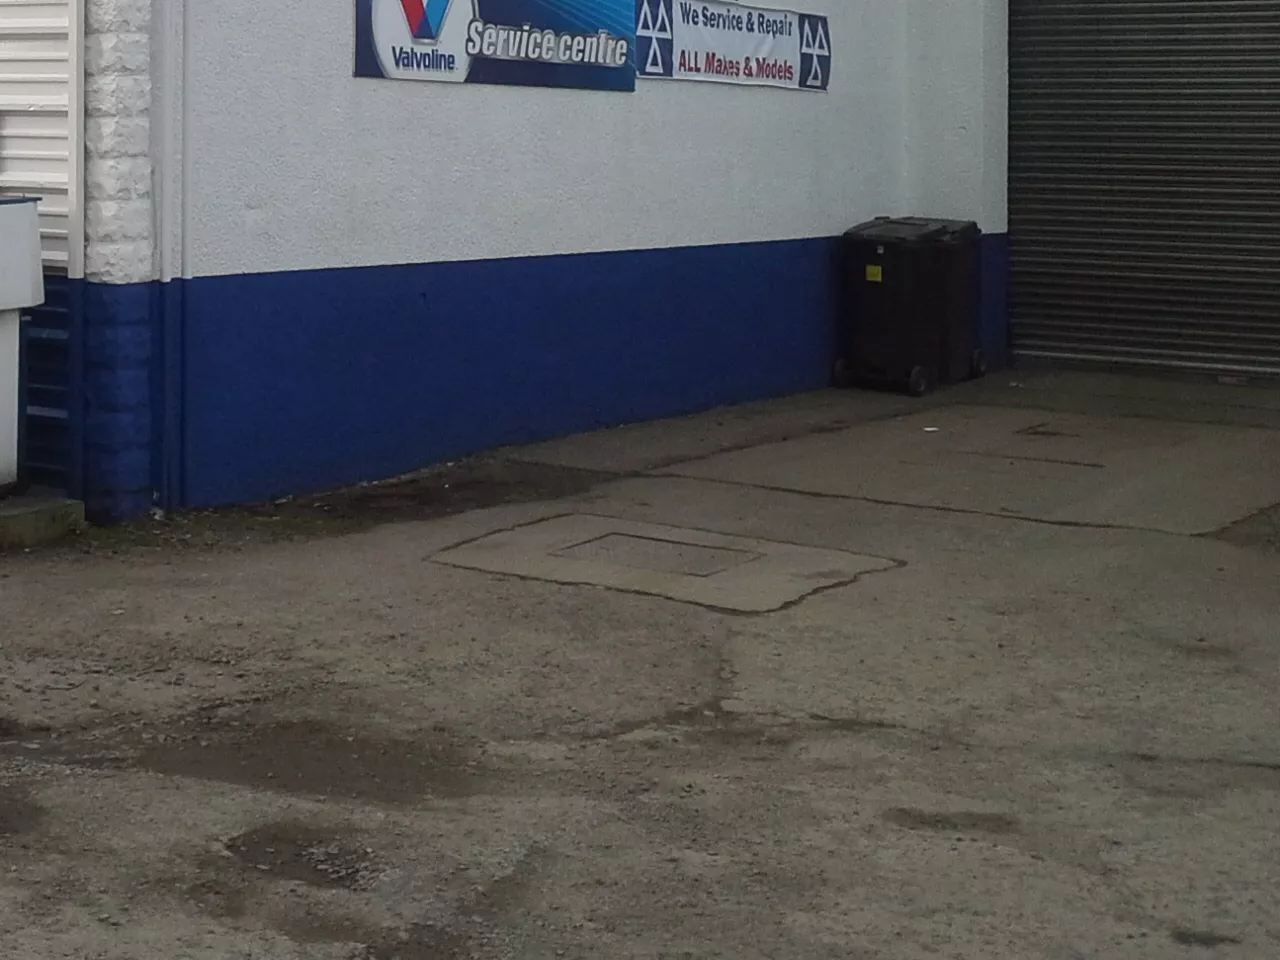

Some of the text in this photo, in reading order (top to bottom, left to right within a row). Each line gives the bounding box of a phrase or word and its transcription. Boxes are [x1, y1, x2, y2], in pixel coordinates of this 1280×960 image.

[679, 1, 793, 39] We Service & Repair
[391, 46, 455, 71] Valvoline
[468, 19, 628, 66] Service centre
[678, 49, 794, 81] ALL Makes & Models
